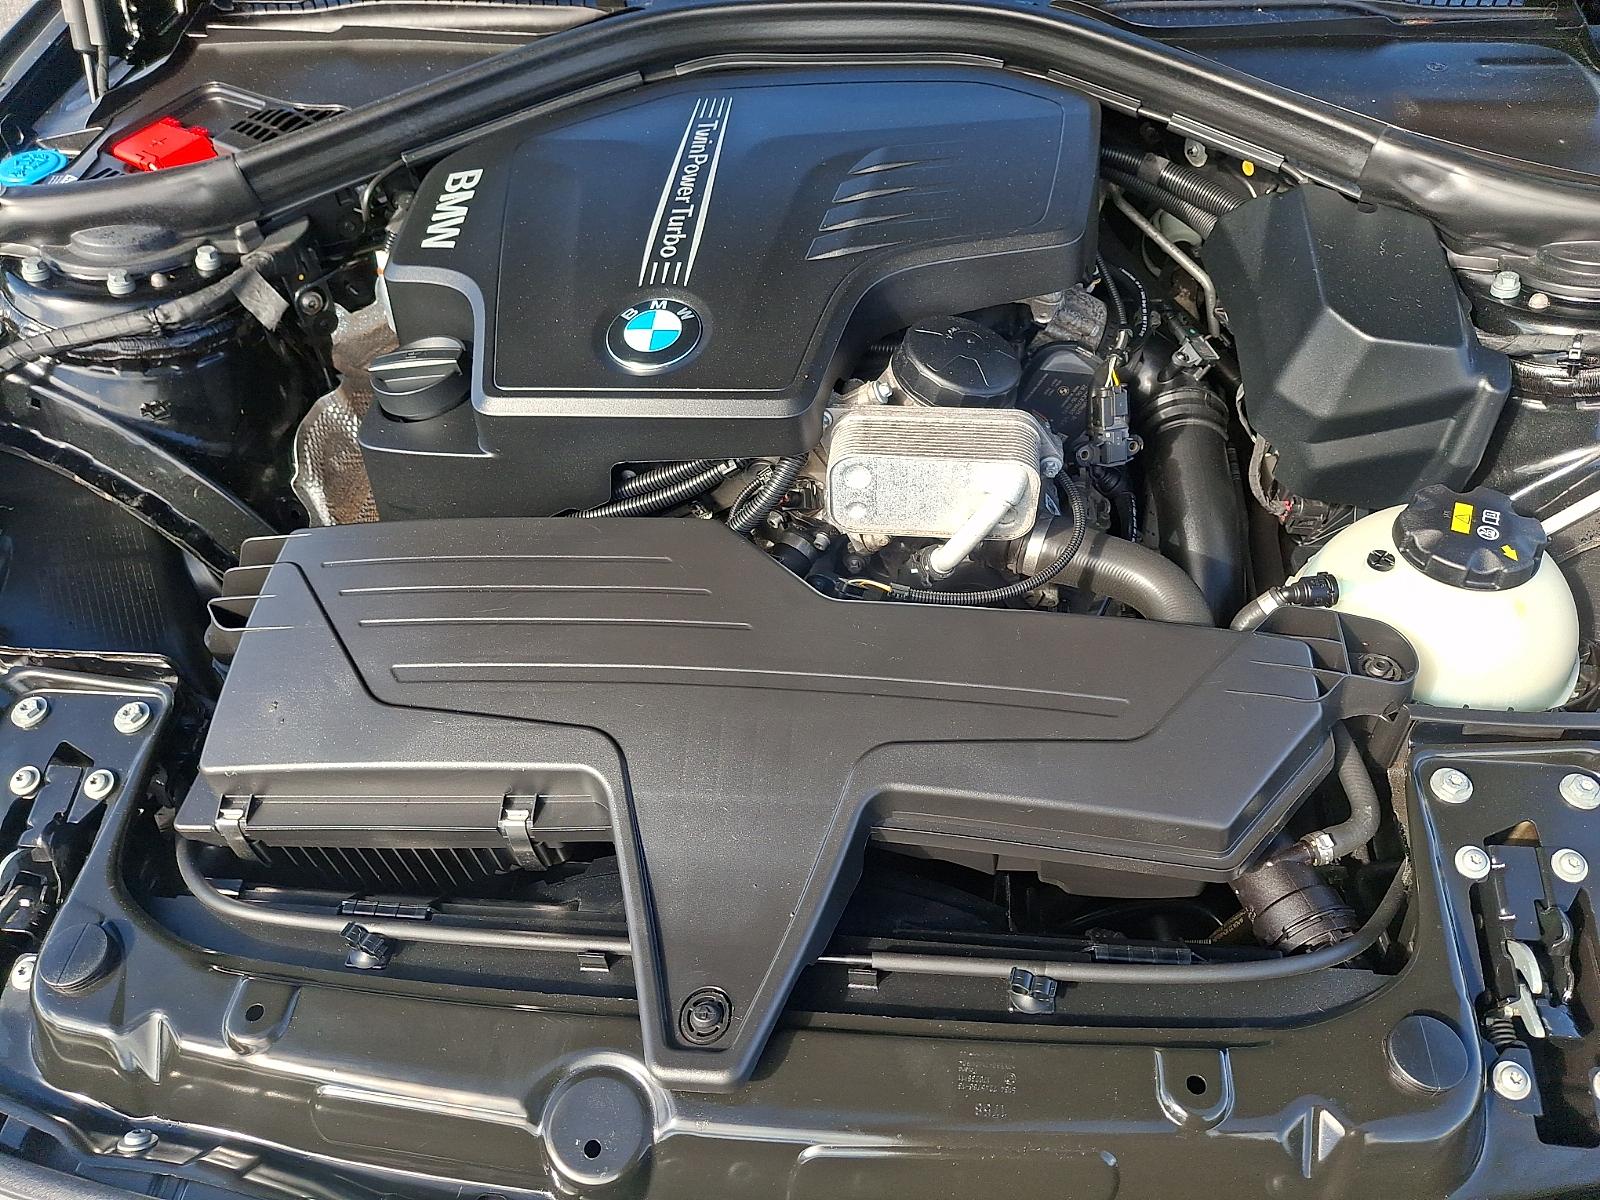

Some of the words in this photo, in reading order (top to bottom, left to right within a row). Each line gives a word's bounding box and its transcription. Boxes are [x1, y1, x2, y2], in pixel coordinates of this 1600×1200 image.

[675, 119, 719, 203] TwinPower
[420, 168, 484, 249] BMW
[660, 204, 694, 259] Turbo
[620, 300, 695, 321] BMW
